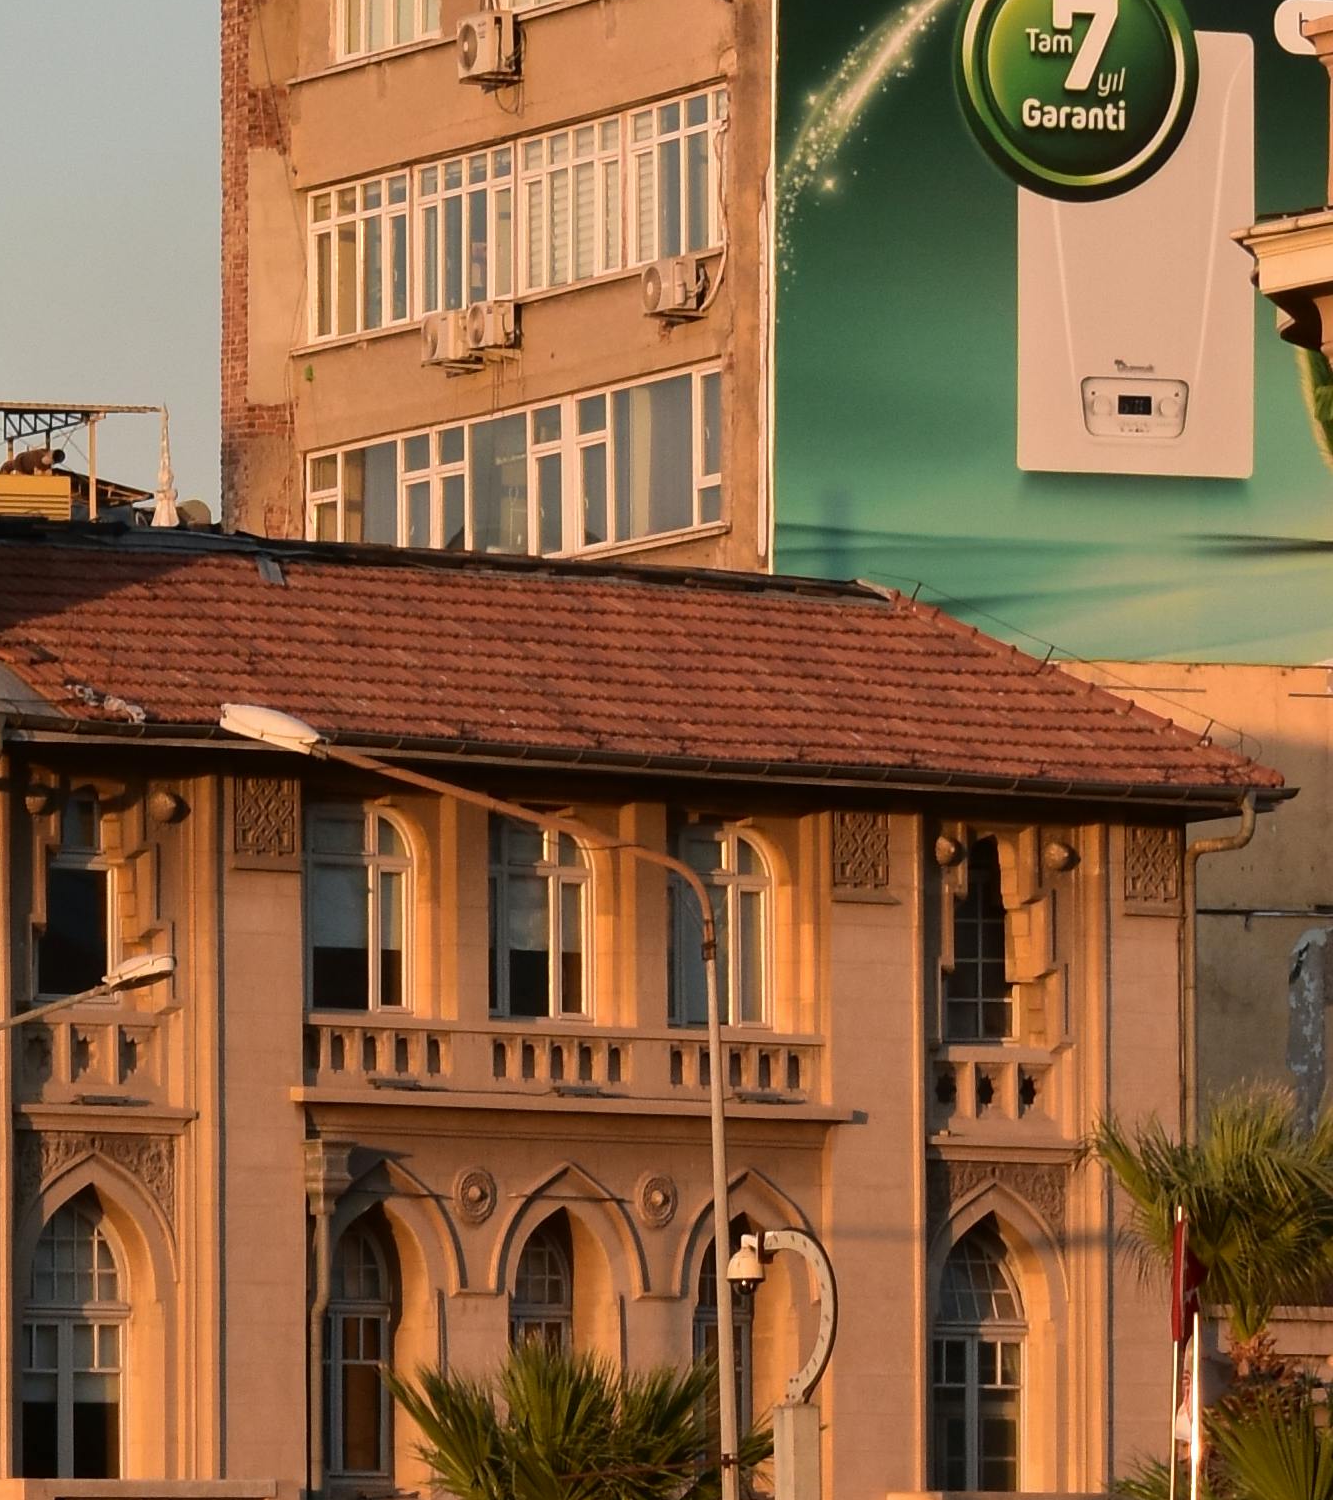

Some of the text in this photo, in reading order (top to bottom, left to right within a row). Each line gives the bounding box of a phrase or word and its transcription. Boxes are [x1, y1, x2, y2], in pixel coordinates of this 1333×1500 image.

[1026, 28, 1073, 54] Tam
[1097, 66, 1125, 98] yıl
[1022, 99, 1126, 132] Garanti
